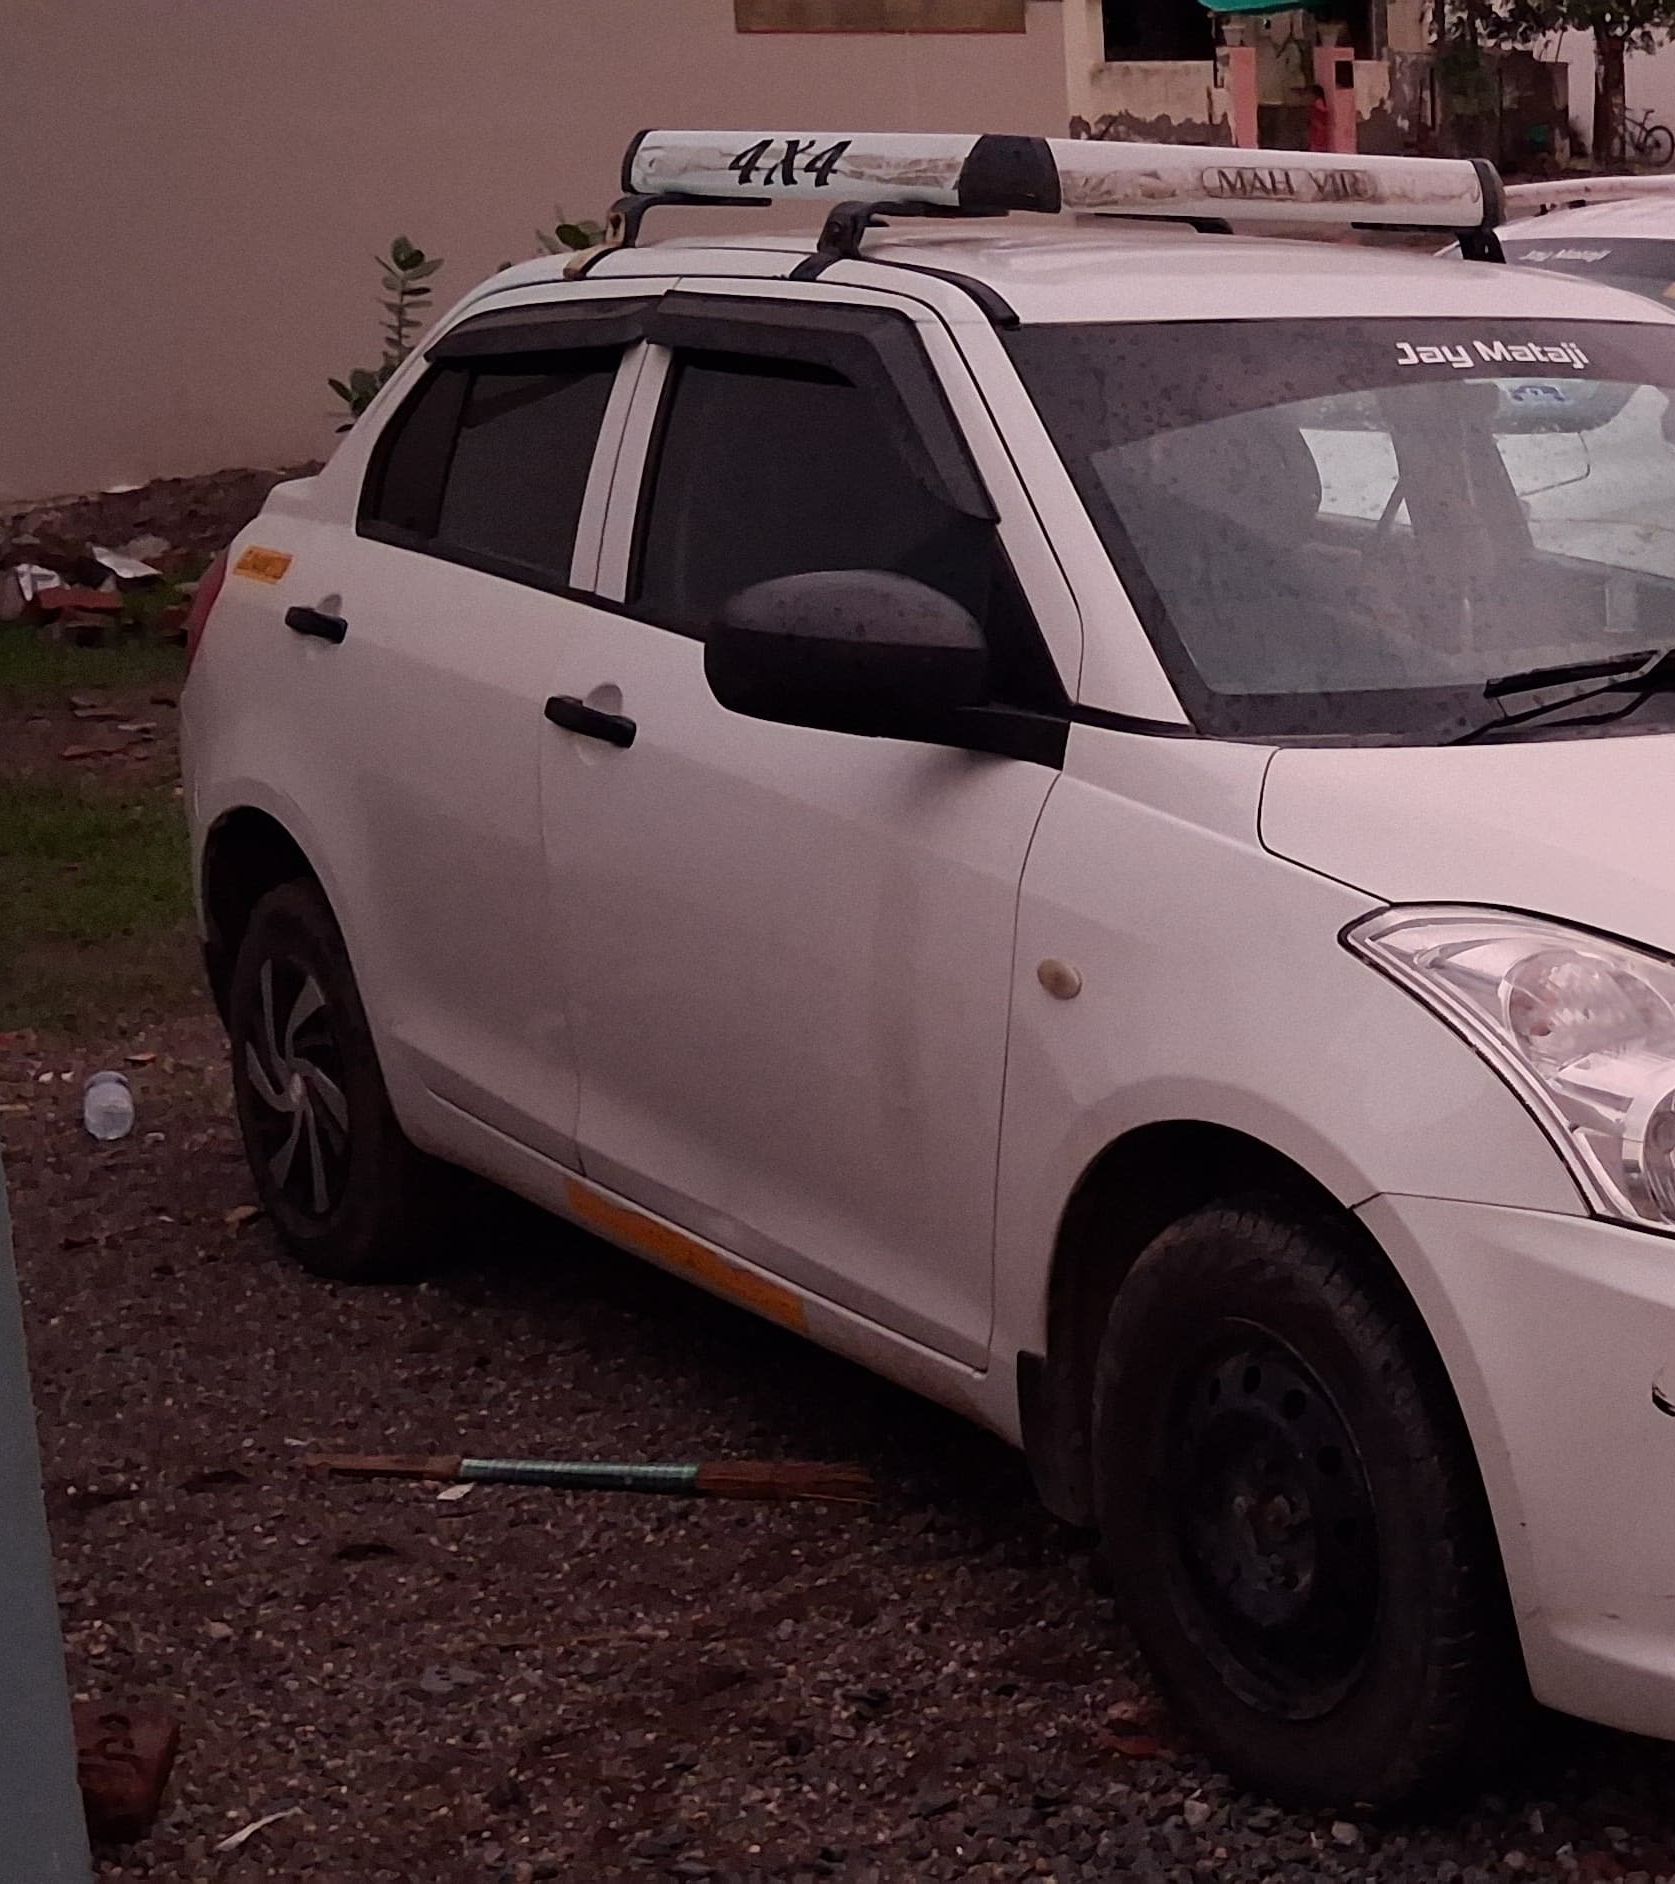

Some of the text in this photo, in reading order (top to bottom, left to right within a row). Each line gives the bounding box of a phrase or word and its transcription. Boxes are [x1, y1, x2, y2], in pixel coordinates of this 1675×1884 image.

[728, 138, 853, 188] 4X4
[1396, 340, 1590, 369] Jay Mataji
